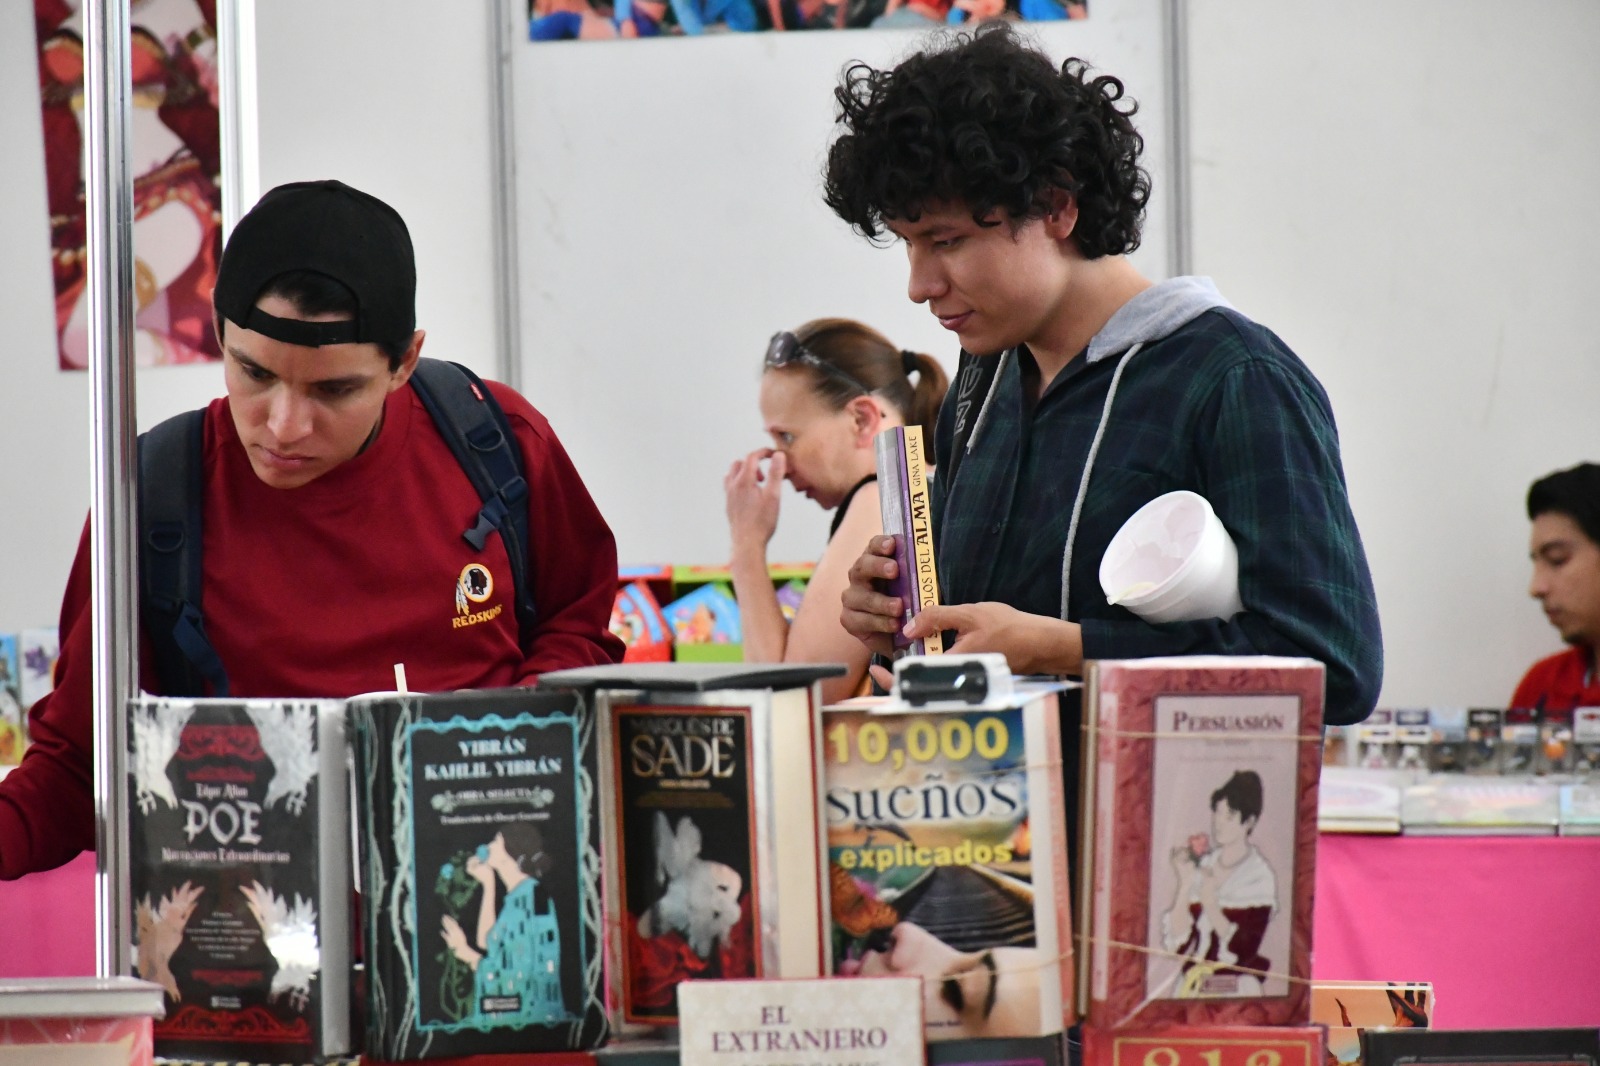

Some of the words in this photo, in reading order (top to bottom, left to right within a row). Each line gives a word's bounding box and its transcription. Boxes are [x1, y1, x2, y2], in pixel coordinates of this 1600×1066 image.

[909, 436, 919, 461] LAKE
[912, 464, 921, 486] GINA
[913, 491, 928, 545] ALMA
[920, 550, 931, 573] DEL
[630, 734, 736, 778] SADE
[828, 716, 1010, 771] 10,000
[424, 763, 492, 780] KAHLIL
[827, 773, 1020, 823] sueños
[181, 799, 262, 845] POE
[839, 840, 1013, 873] explicados
[761, 1006, 791, 1025] EL
[712, 1027, 888, 1053] EXTRANJERO
